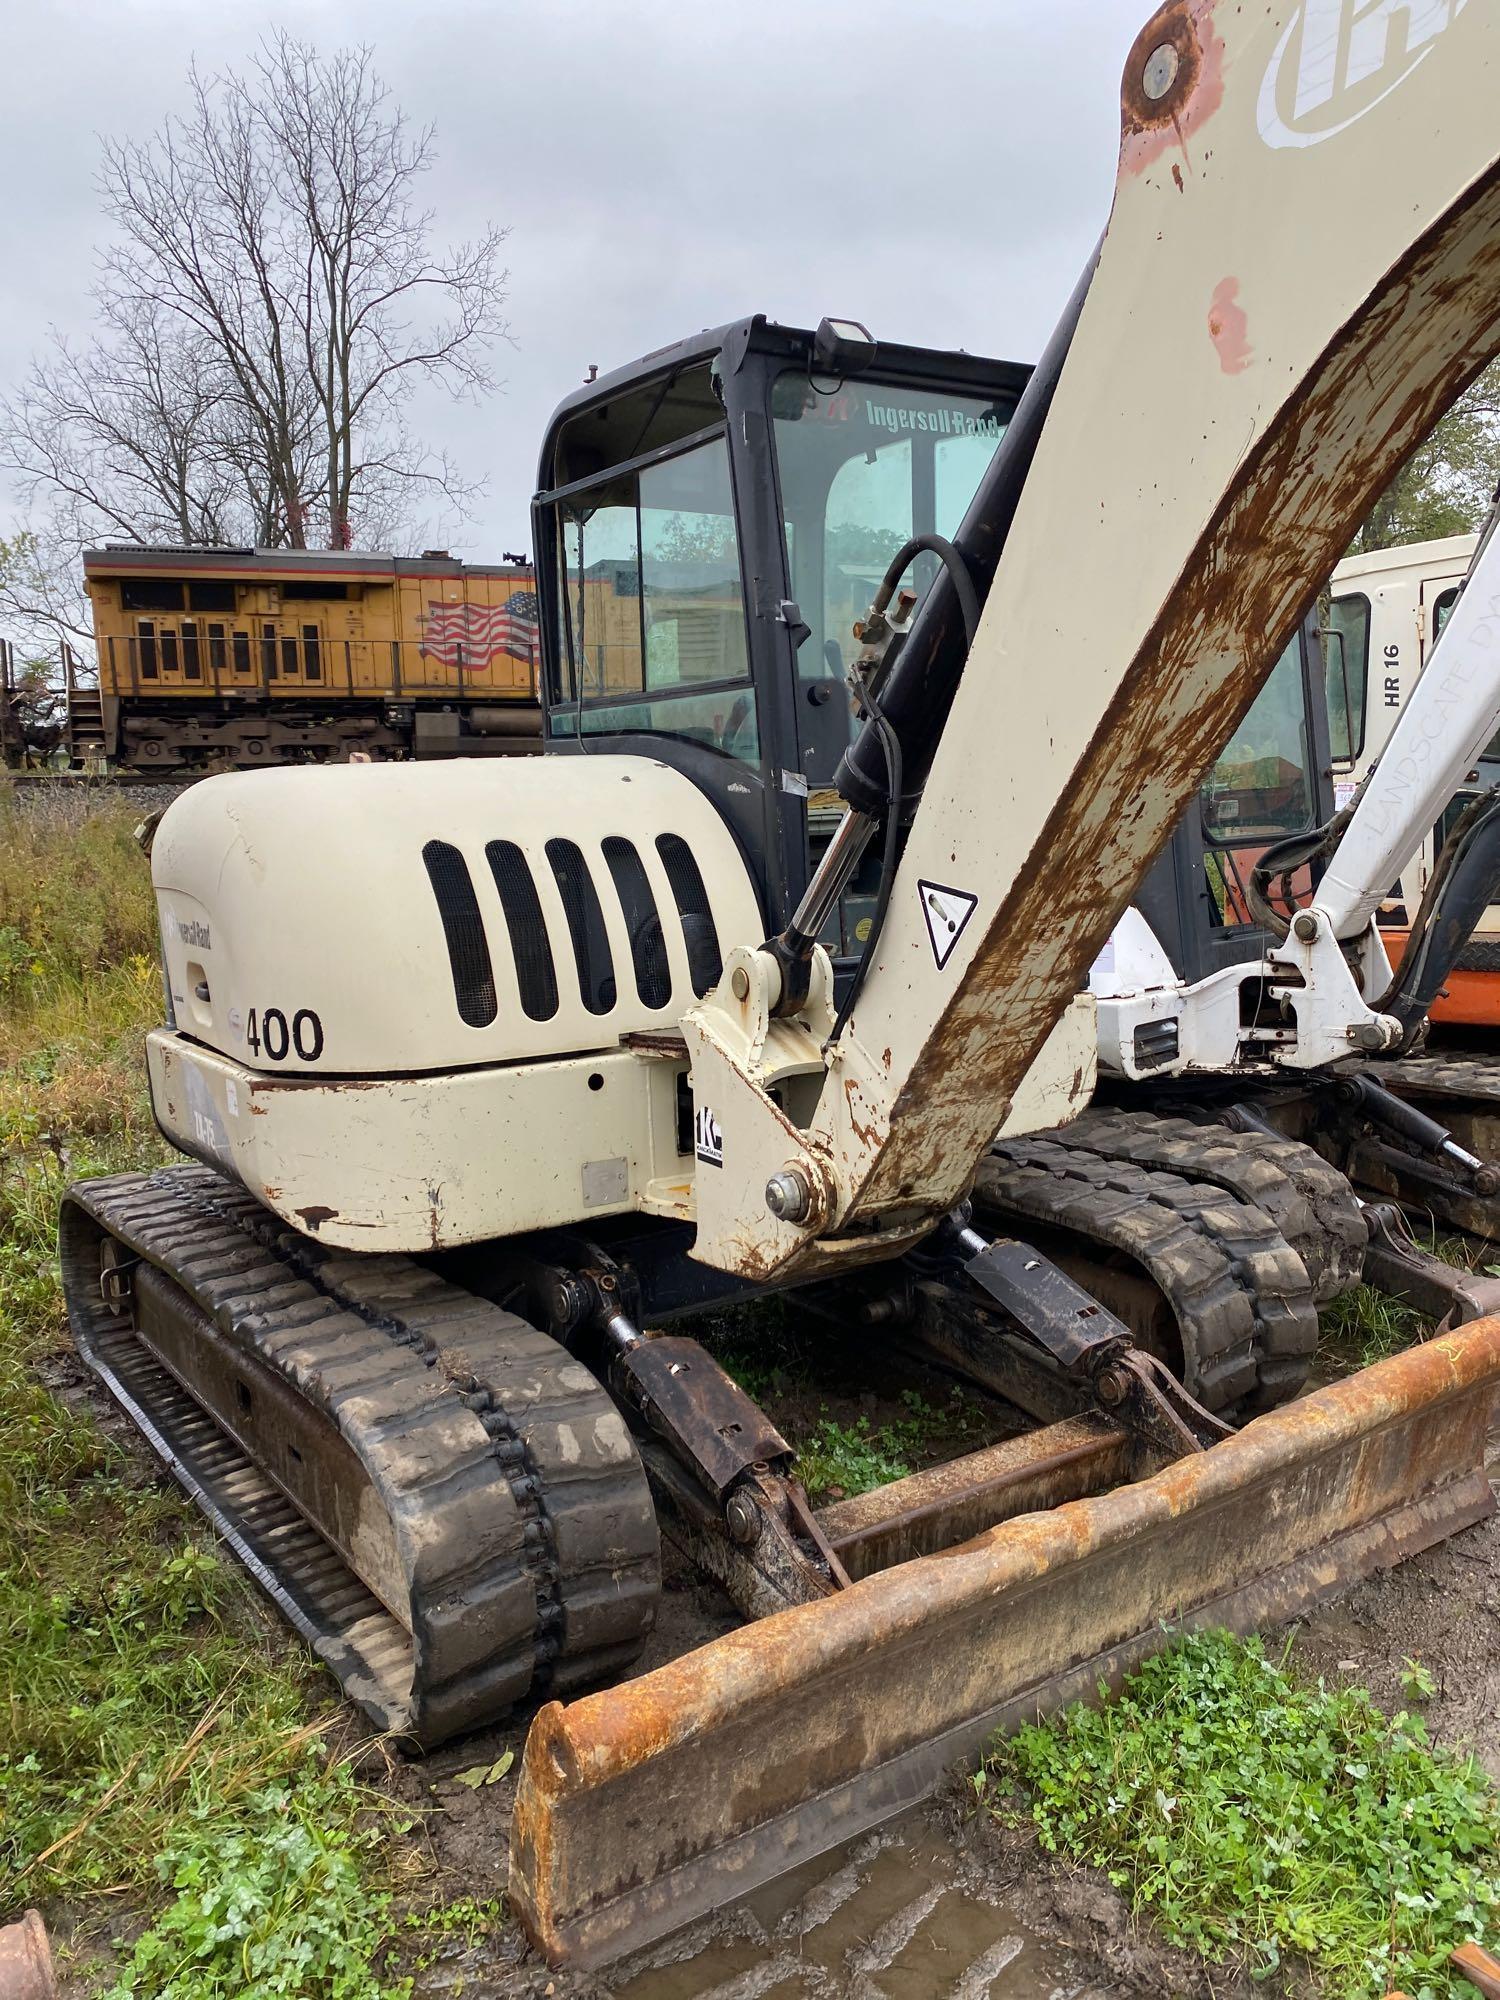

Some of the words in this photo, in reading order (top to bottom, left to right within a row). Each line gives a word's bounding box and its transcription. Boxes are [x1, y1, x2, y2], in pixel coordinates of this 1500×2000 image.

[1383, 644, 1399, 668] 16
[1384, 677, 1400, 707] HR
[1363, 660, 1480, 838] LANDSCAPE
[246, 1007, 324, 1062] 400
